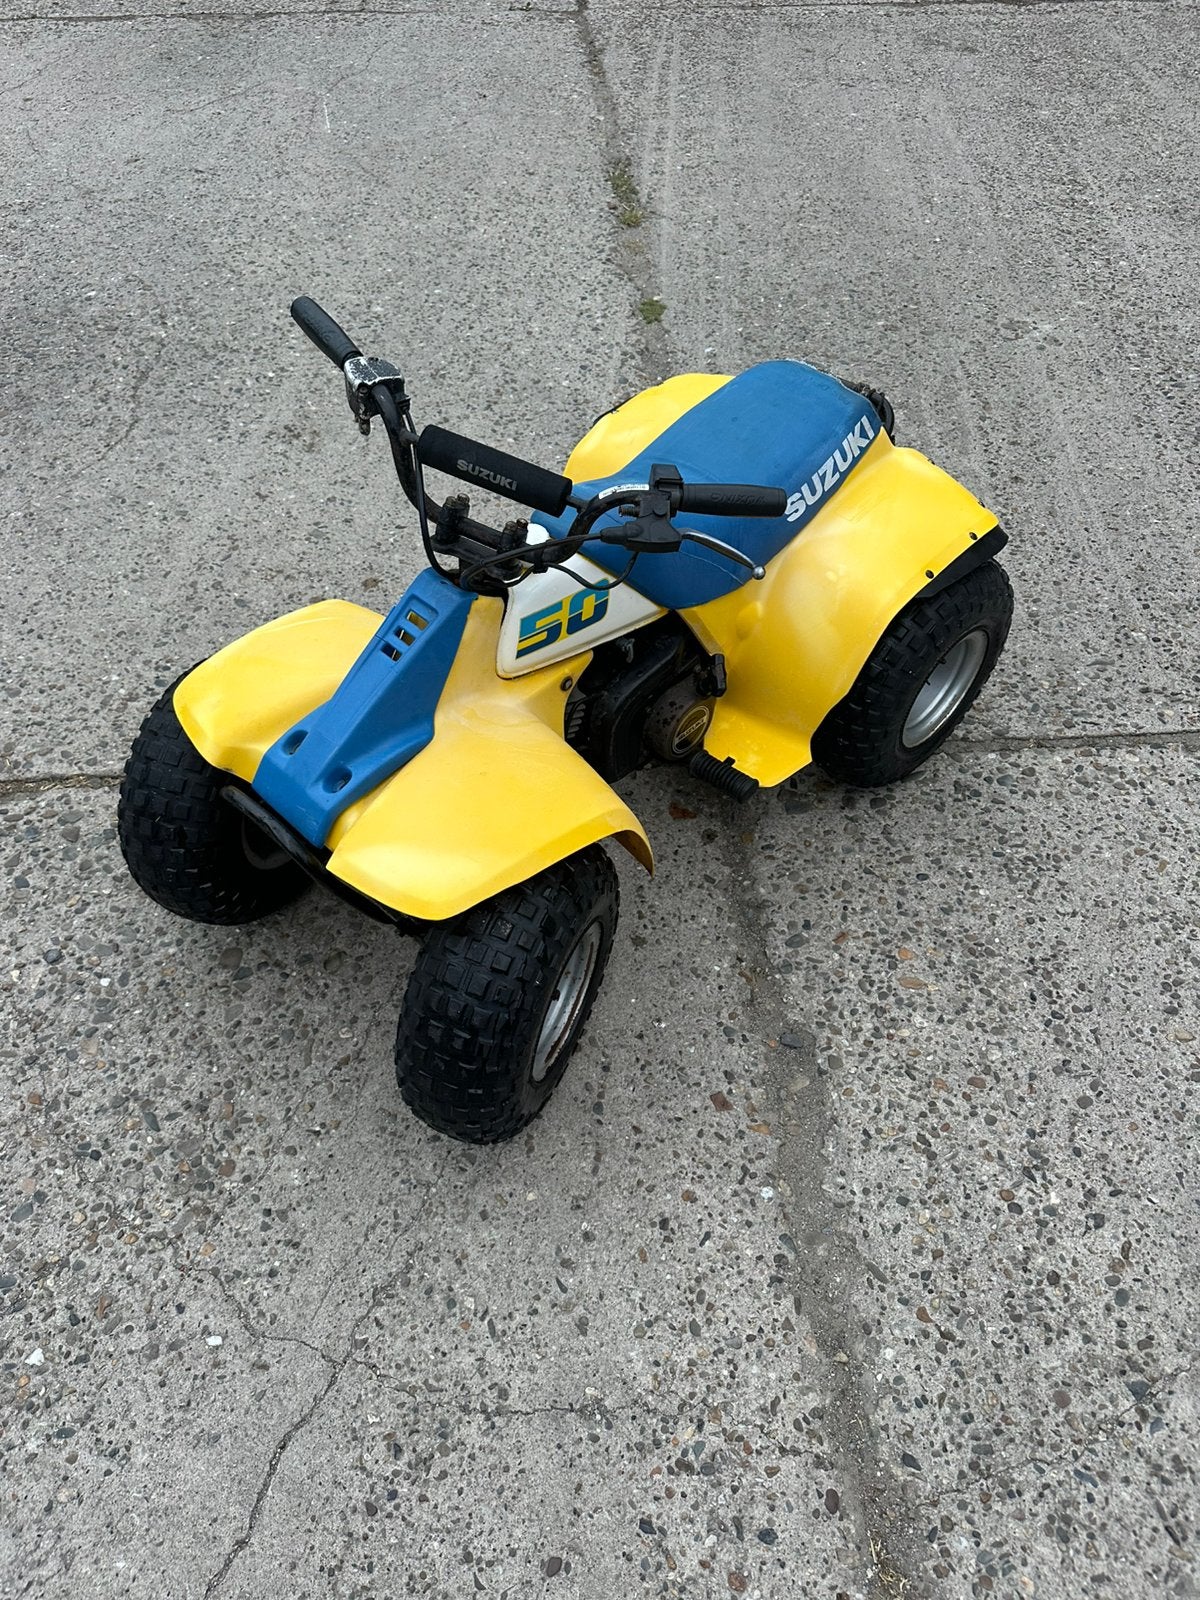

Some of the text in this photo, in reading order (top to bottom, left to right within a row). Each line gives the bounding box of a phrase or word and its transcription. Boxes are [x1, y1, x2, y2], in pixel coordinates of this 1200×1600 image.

[456, 459, 518, 491] SUZUKI
[784, 415, 875, 522] SUZUKI
[516, 578, 610, 660] 50
